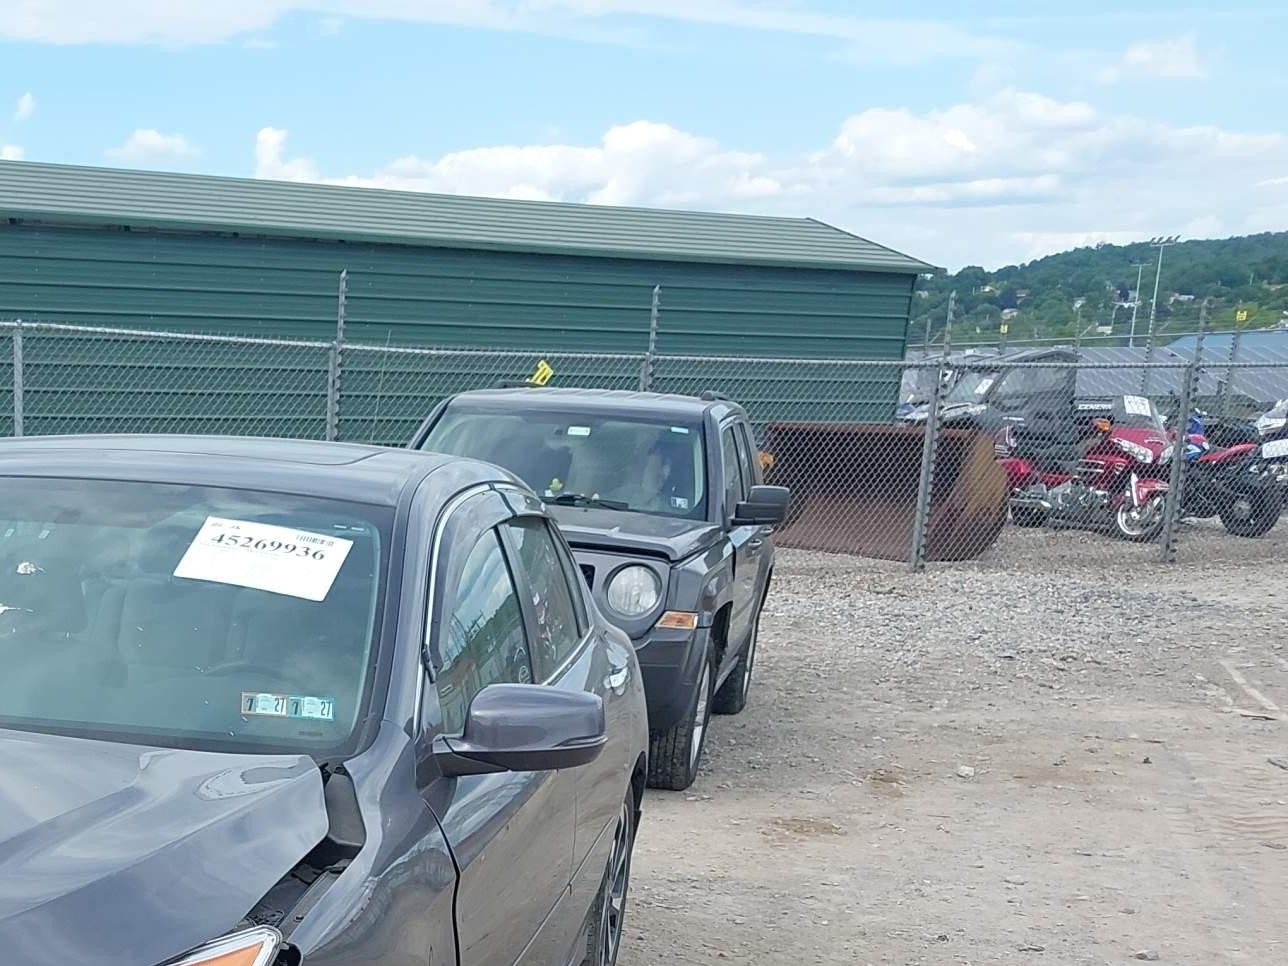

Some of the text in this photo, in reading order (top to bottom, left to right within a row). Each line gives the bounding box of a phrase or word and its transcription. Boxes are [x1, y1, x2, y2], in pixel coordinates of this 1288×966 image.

[211, 533, 326, 561] 45269936
[274, 697, 285, 713] 27
[320, 701, 332, 718] 27
